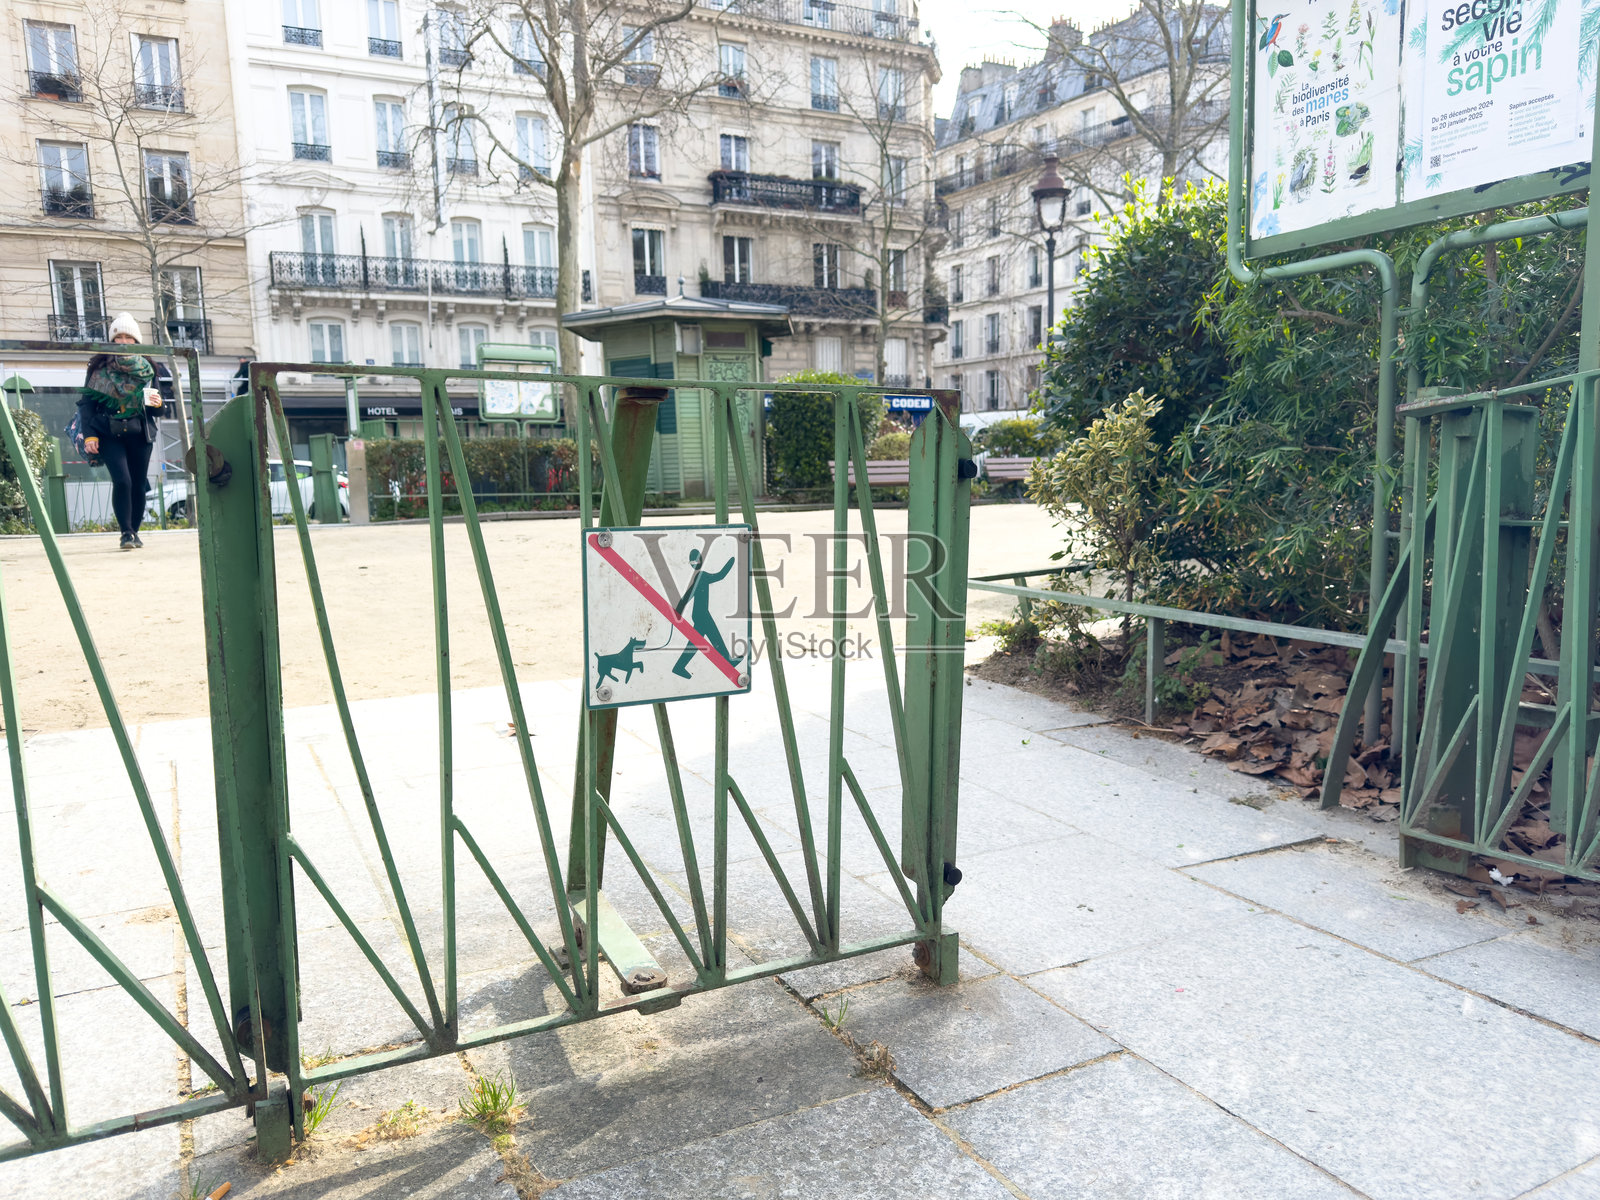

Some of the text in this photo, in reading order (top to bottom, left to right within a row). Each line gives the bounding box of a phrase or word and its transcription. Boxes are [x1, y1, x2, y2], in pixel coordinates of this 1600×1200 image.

[1441, 0, 1530, 31] seco
[1482, 10, 1523, 42] vie
[1453, 40, 1503, 67] à votre
[1446, 37, 1543, 97] sapin
[1292, 74, 1350, 105] biodiversité
[1301, 82, 1310, 91] La
[1292, 88, 1349, 117] des mares
[1431, 99, 1494, 124] Du 26 décembre 2024
[1509, 101, 1527, 111] Sapins
[1528, 93, 1555, 105] acceptés
[1305, 110, 1330, 128] Paris
[1439, 121, 1447, 130] 20
[1447, 116, 1468, 128] janvier
[1468, 110, 1484, 121] 2025
[367, 407, 398, 416] HOTEL
[892, 398, 931, 409] CODEM
